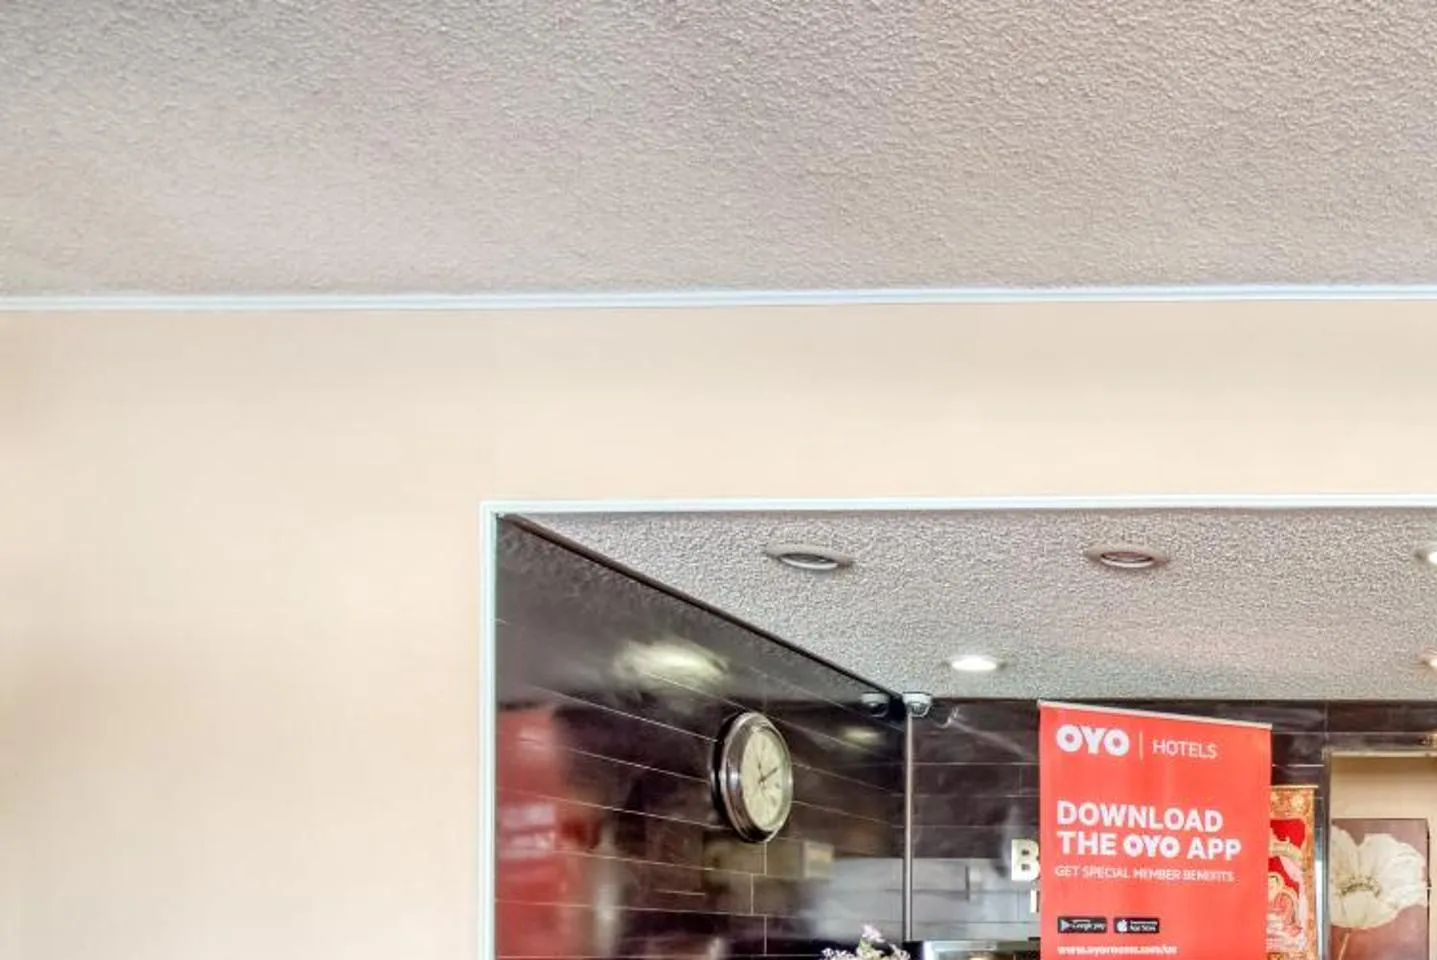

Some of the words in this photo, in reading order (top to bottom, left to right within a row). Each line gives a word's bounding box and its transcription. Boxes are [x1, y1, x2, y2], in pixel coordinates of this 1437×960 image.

[1056, 724, 1130, 756] OYO
[1152, 739, 1218, 759] HOTELS
[1056, 800, 1223, 832] DOWNLOAD
[1056, 831, 1117, 855] THE
[1123, 834, 1181, 858] OYO
[1187, 837, 1242, 860] APP
[1055, 865, 1079, 877] GET
[1082, 866, 1129, 879] SPECIAL
[1133, 867, 1180, 880] MEMBER
[1183, 869, 1235, 882] BENEFITS
